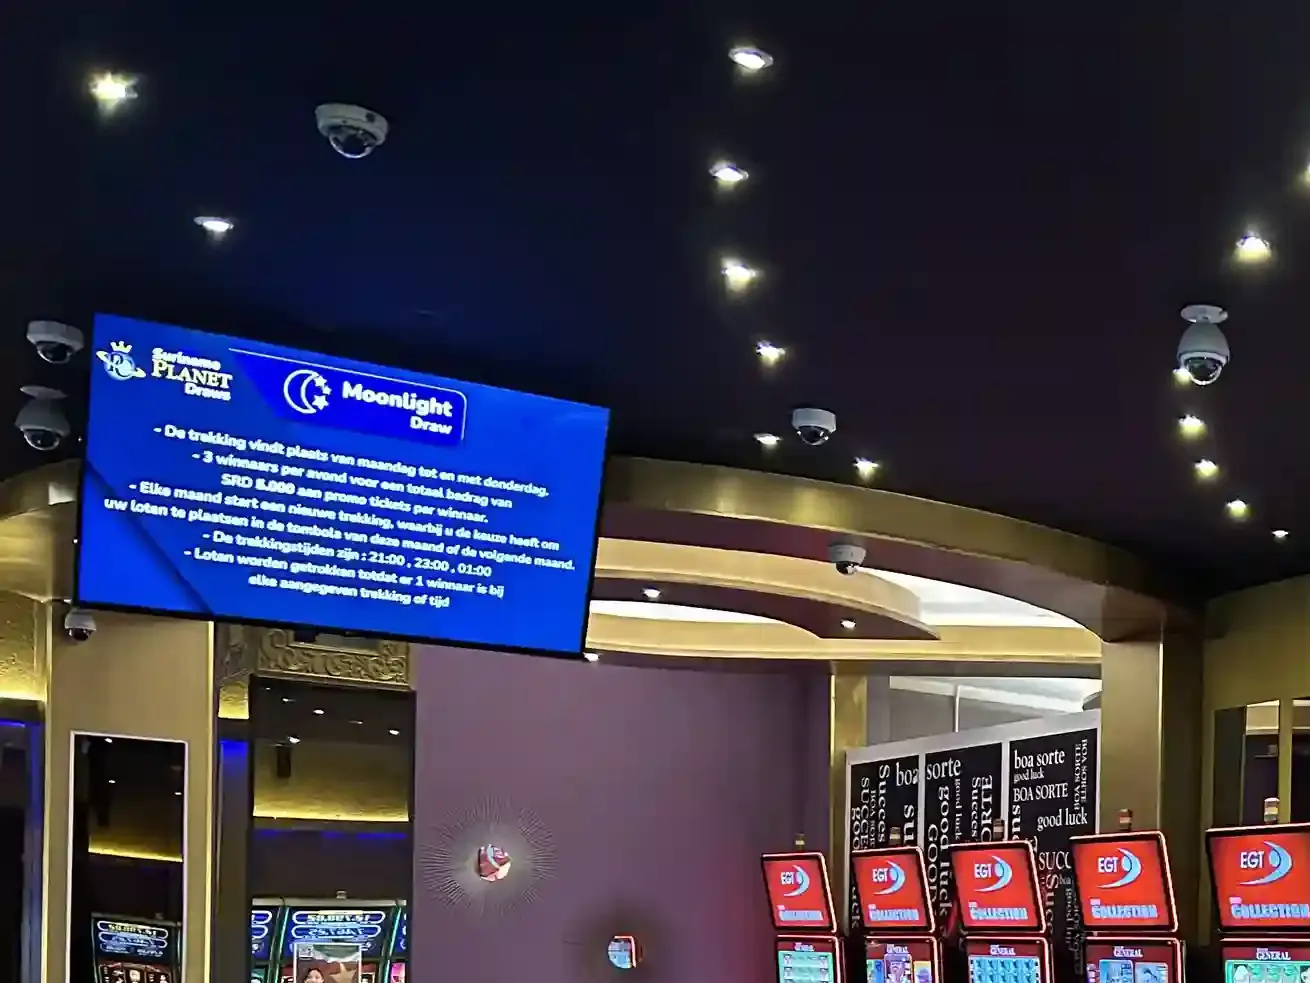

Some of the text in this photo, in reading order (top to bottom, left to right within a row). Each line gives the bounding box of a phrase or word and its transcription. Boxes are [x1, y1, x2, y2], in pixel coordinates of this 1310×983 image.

[152, 347, 222, 371] Suriname
[152, 358, 233, 389] PLANET
[184, 382, 231, 401] Draws
[342, 380, 453, 417] Moonlight
[410, 415, 453, 434] Draw
[164, 424, 186, 439] De
[187, 429, 246, 450] trekking
[248, 438, 285, 455] vindt
[286, 445, 329, 462] plaats
[330, 453, 356, 466] van
[357, 457, 417, 478] maandag
[418, 466, 438, 479] tot
[439, 471, 455, 481] en
[457, 473, 483, 486] met
[202, 450, 513, 509] 3 winnaars per avond voor een totaal bedrag van
[221, 473, 253, 489] SRD
[323, 491, 368, 505] promo
[369, 496, 411, 512] tickets
[412, 504, 435, 515] per
[139, 481, 172, 497] Elke
[173, 487, 222, 504] maand
[224, 495, 260, 509] start
[260, 500, 287, 513] een
[288, 503, 336, 520] nieuwe
[396, 520, 443, 537] waarbij
[455, 527, 472, 539] de
[473, 529, 507, 544] keuze
[509, 534, 540, 549] heeft
[541, 540, 560, 551] om
[104, 498, 128, 511] uw
[130, 499, 168, 516] loten
[170, 506, 186, 518] te
[188, 508, 249, 527] plaatsen
[250, 516, 265, 529] in
[266, 519, 285, 532] de
[286, 522, 342, 540] tombola
[344, 532, 368, 543] van
[369, 533, 400, 547] deze
[401, 539, 445, 553] maand
[445, 544, 460, 555] of
[461, 546, 477, 557] de
[479, 550, 532, 563] volgende
[213, 530, 492, 577] De trekkingstijden zijn 21:00 23:00 01:00
[194, 547, 504, 598] Loten worden getrokken totdat er 1 winnaar is bij
[248, 574, 450, 608] elke aangegeven trekking of tijd
[896, 757, 962, 787] boa sorte
[1014, 749, 1065, 769] boa sorte
[1013, 769, 1030, 784] good
[1013, 782, 1069, 802] BOA SORTE
[981, 774, 993, 842] ORTE
[1037, 806, 1088, 832] good luck
[851, 806, 861, 850] goo
[938, 786, 952, 916] good luck
[1038, 851, 1072, 870] SUCC
[1240, 851, 1265, 869] EGT
[780, 871, 795, 885] EGT
[873, 868, 889, 883] EGT
[974, 863, 993, 878] EGT
[1098, 857, 1119, 873] EGT
[1231, 903, 1310, 919] COLLECTION
[1256, 950, 1292, 961] GENERAL
